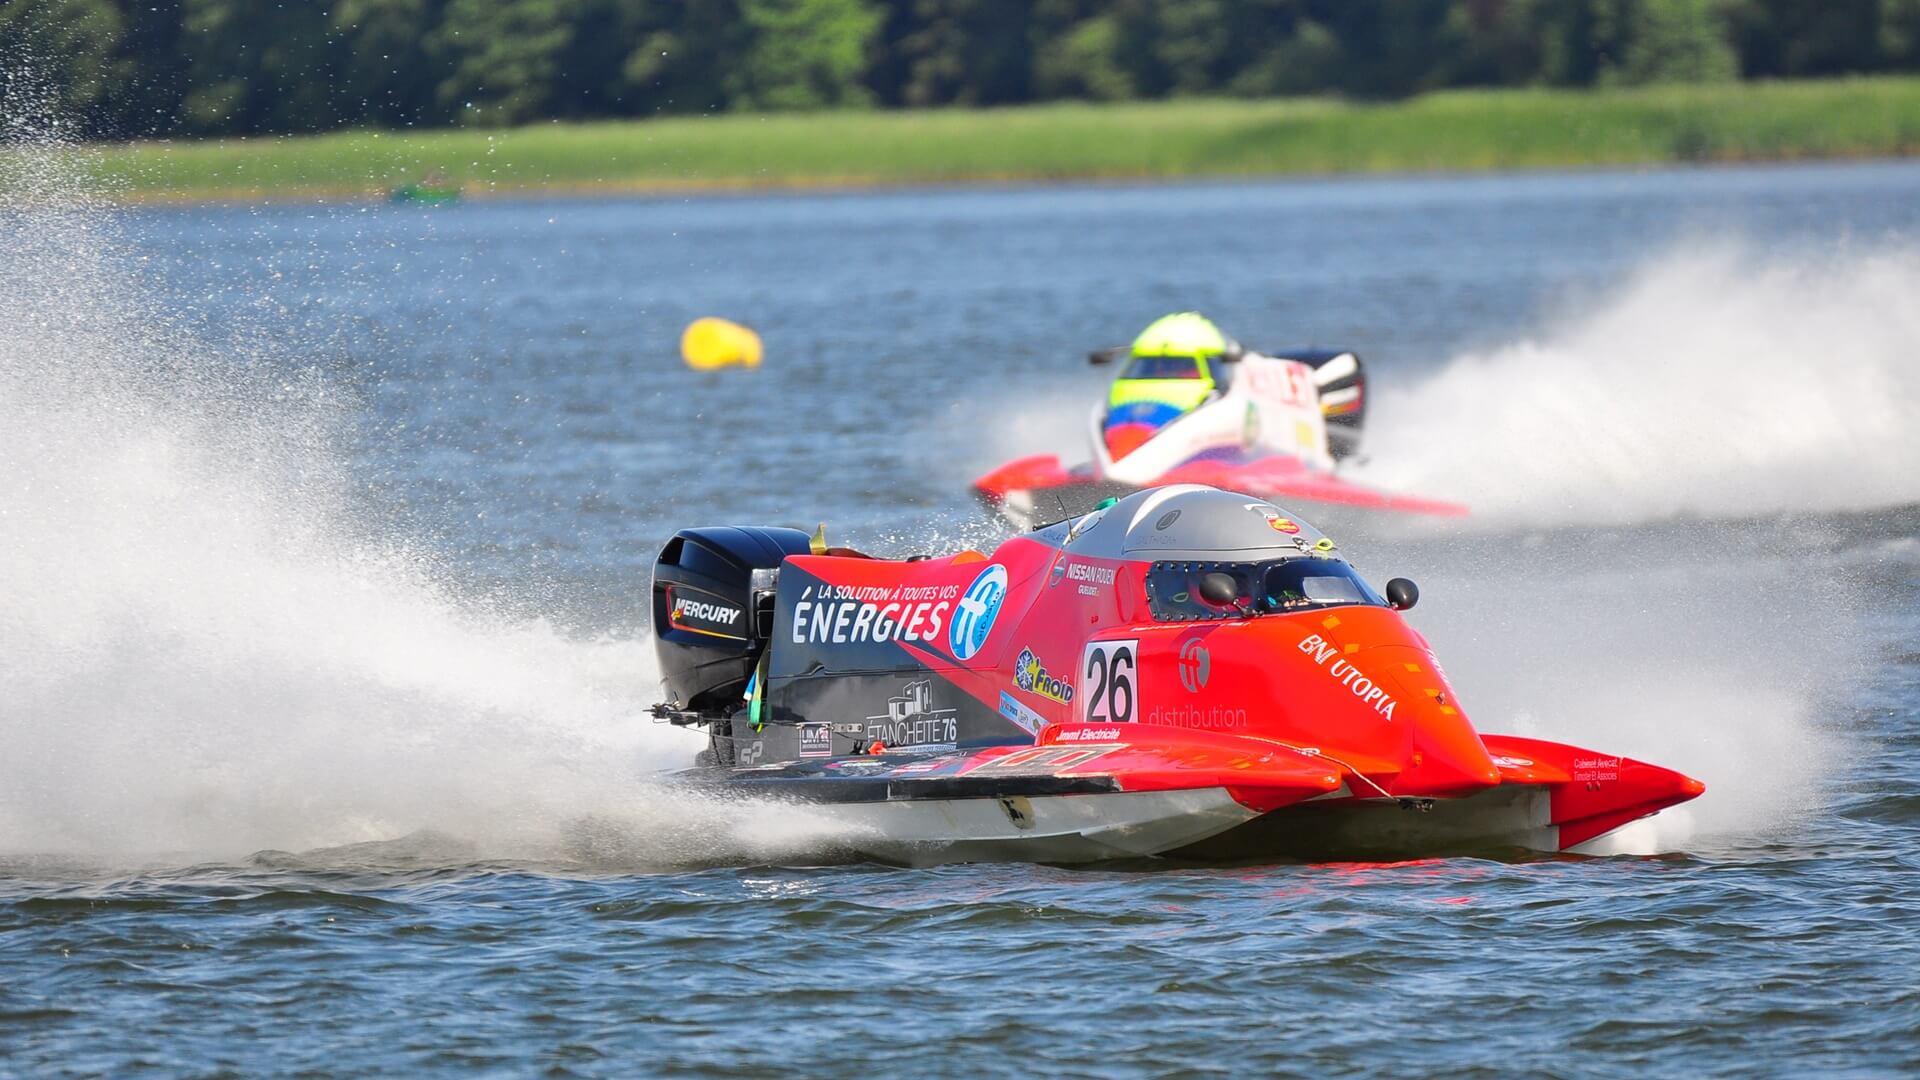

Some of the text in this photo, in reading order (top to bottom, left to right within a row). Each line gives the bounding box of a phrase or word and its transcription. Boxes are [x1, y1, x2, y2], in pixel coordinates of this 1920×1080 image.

[1066, 563, 1097, 582] NISSAN
[818, 584, 831, 600] LA
[834, 585, 892, 601] SOLUTION
[901, 586, 939, 601] TOUTES
[939, 584, 960, 600] VOS
[673, 597, 741, 625] MERCURY
[792, 586, 950, 644] ÉNERGIES
[1086, 646, 1133, 723] 26
[1297, 633, 1339, 665] BNI
[1329, 658, 1397, 722] UTOPIA
[866, 713, 957, 747] ÉTANCHÉITÉ 76
[1148, 703, 1248, 728] distribution
